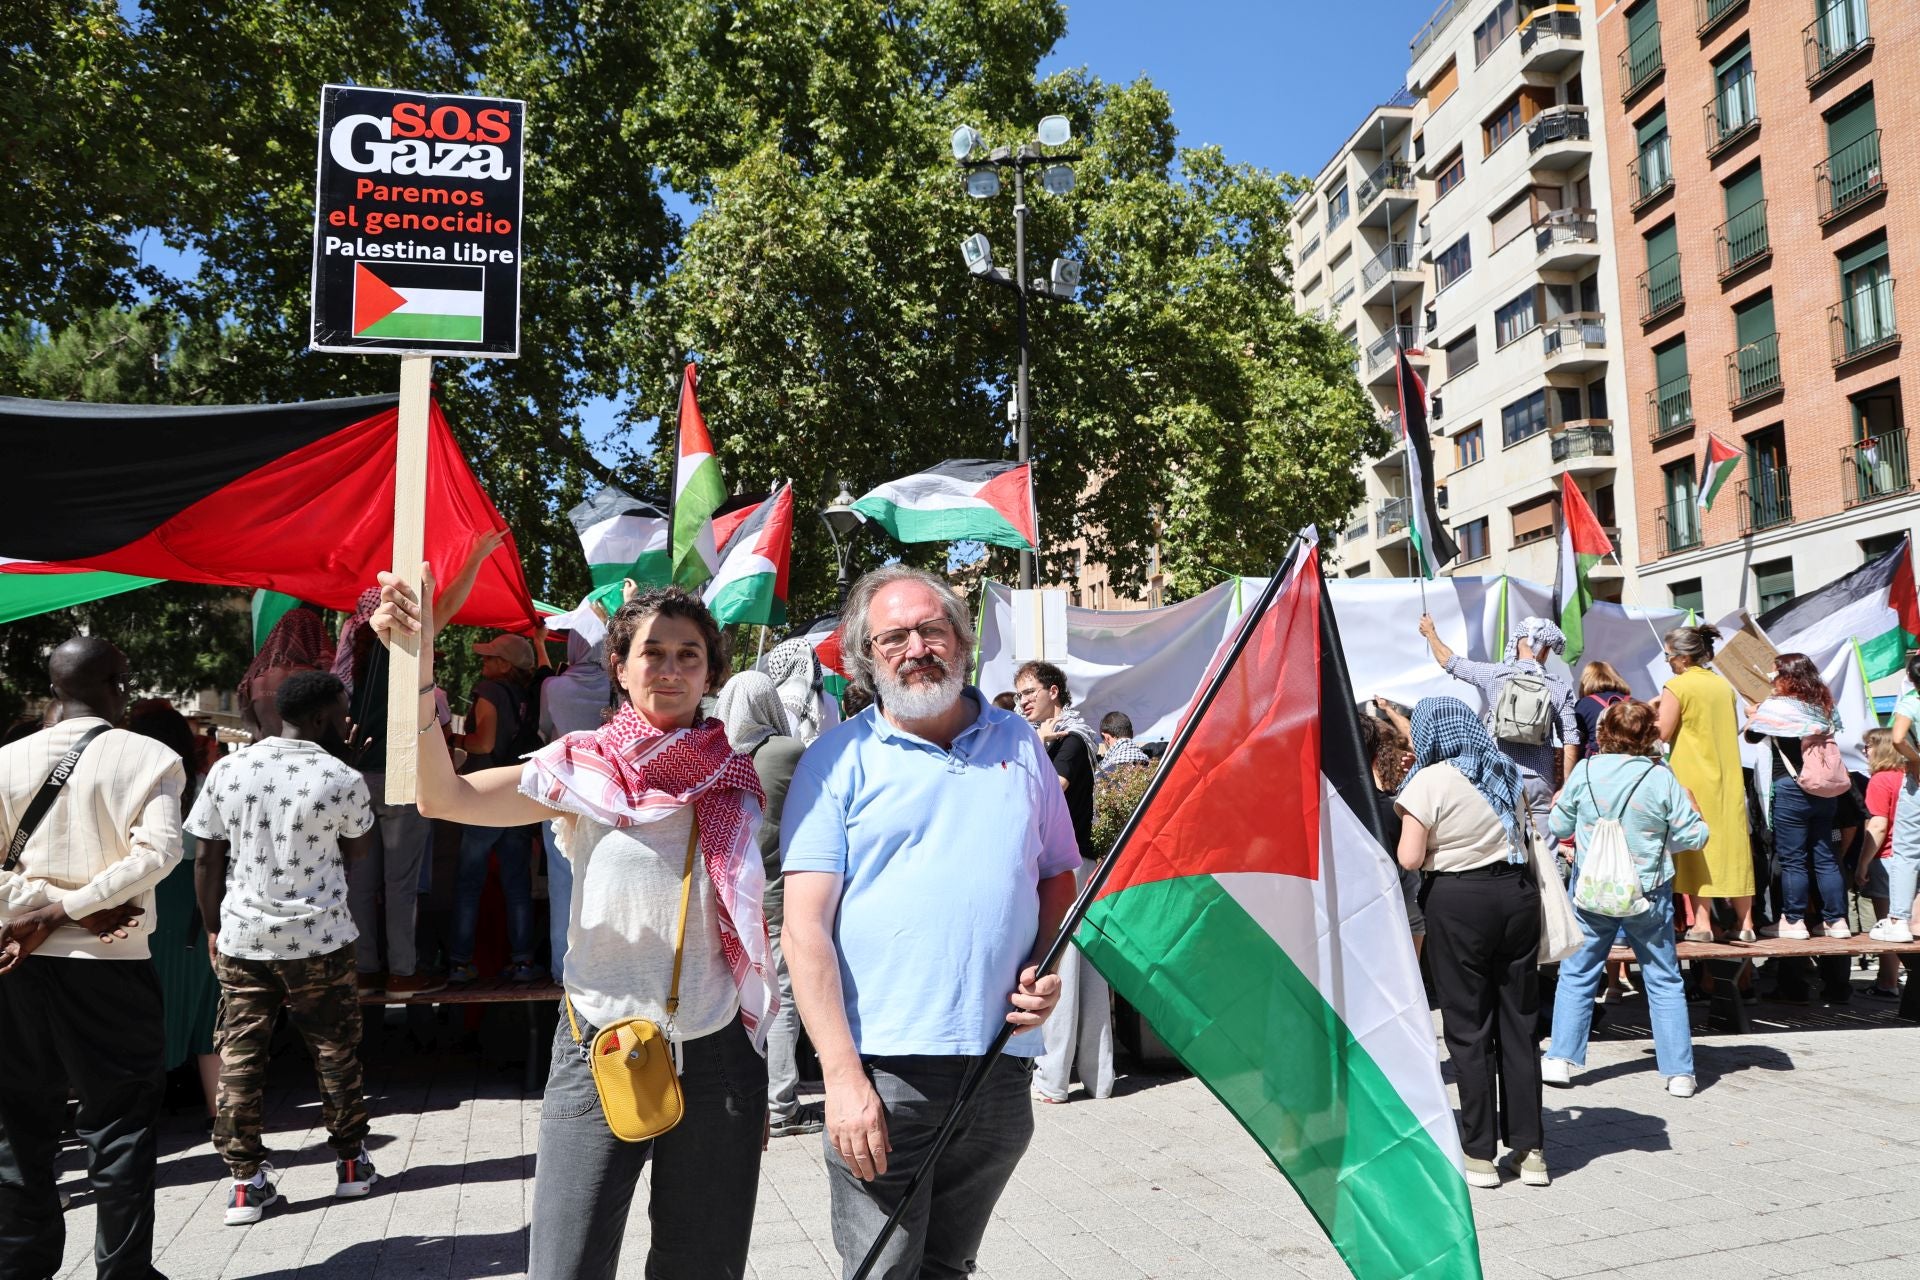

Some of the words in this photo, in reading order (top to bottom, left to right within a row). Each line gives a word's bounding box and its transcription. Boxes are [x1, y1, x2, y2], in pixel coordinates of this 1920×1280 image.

[329, 113, 512, 181] Gaza
[356, 178, 484, 206] Paremos
[328, 205, 359, 227] el
[366, 211, 512, 235] genocidio
[325, 236, 446, 261] Palestina
[453, 242, 514, 264] libre
[47, 750, 80, 787] BIMBA
[8, 828, 29, 862] BIMBA
